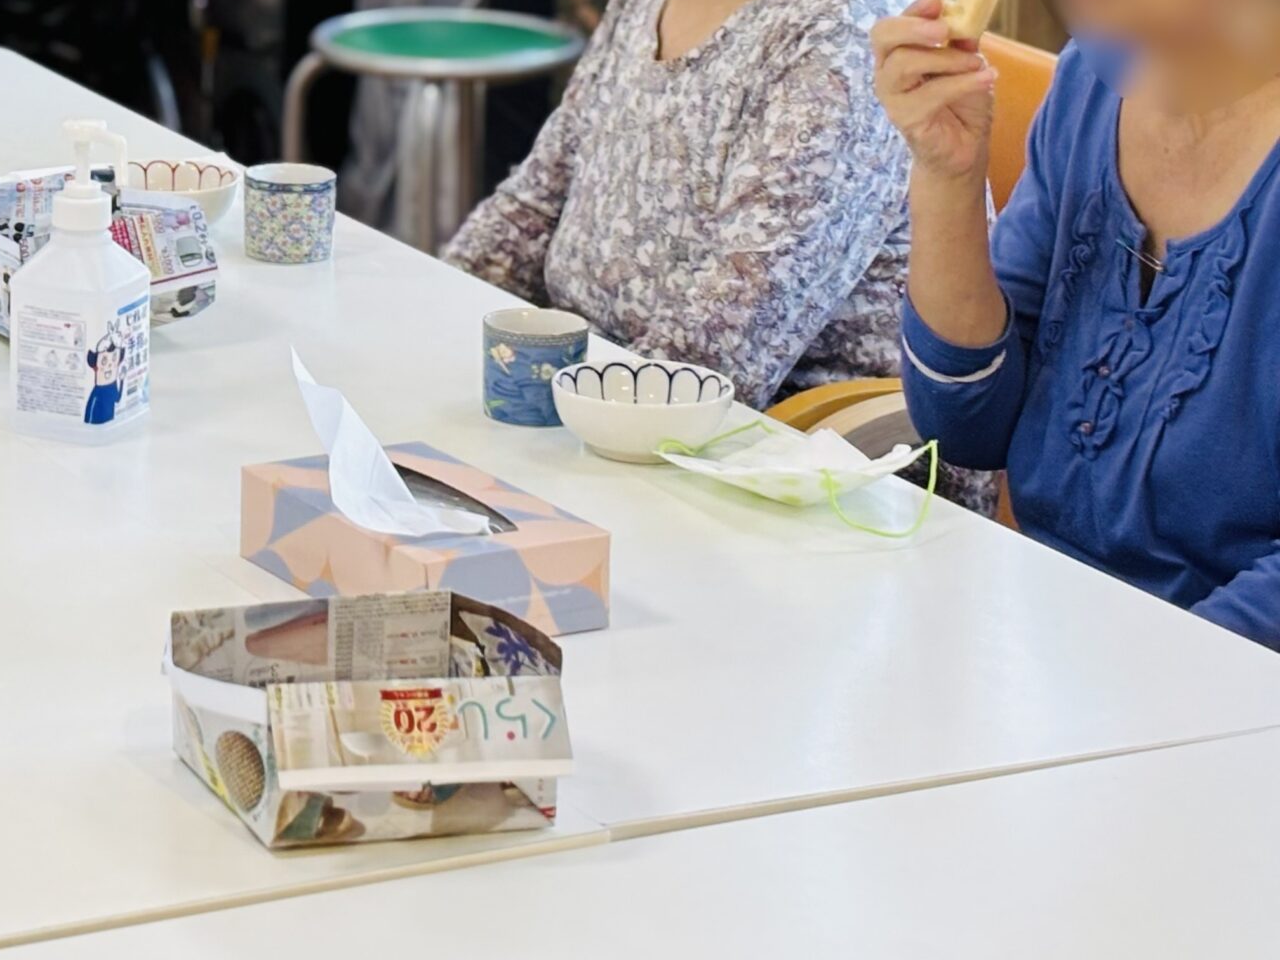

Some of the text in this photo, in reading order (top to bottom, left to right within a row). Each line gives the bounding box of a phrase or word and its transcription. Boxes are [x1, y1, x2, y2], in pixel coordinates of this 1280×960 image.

[393, 705, 438, 735] 20
[457, 697, 557, 741] くらし
